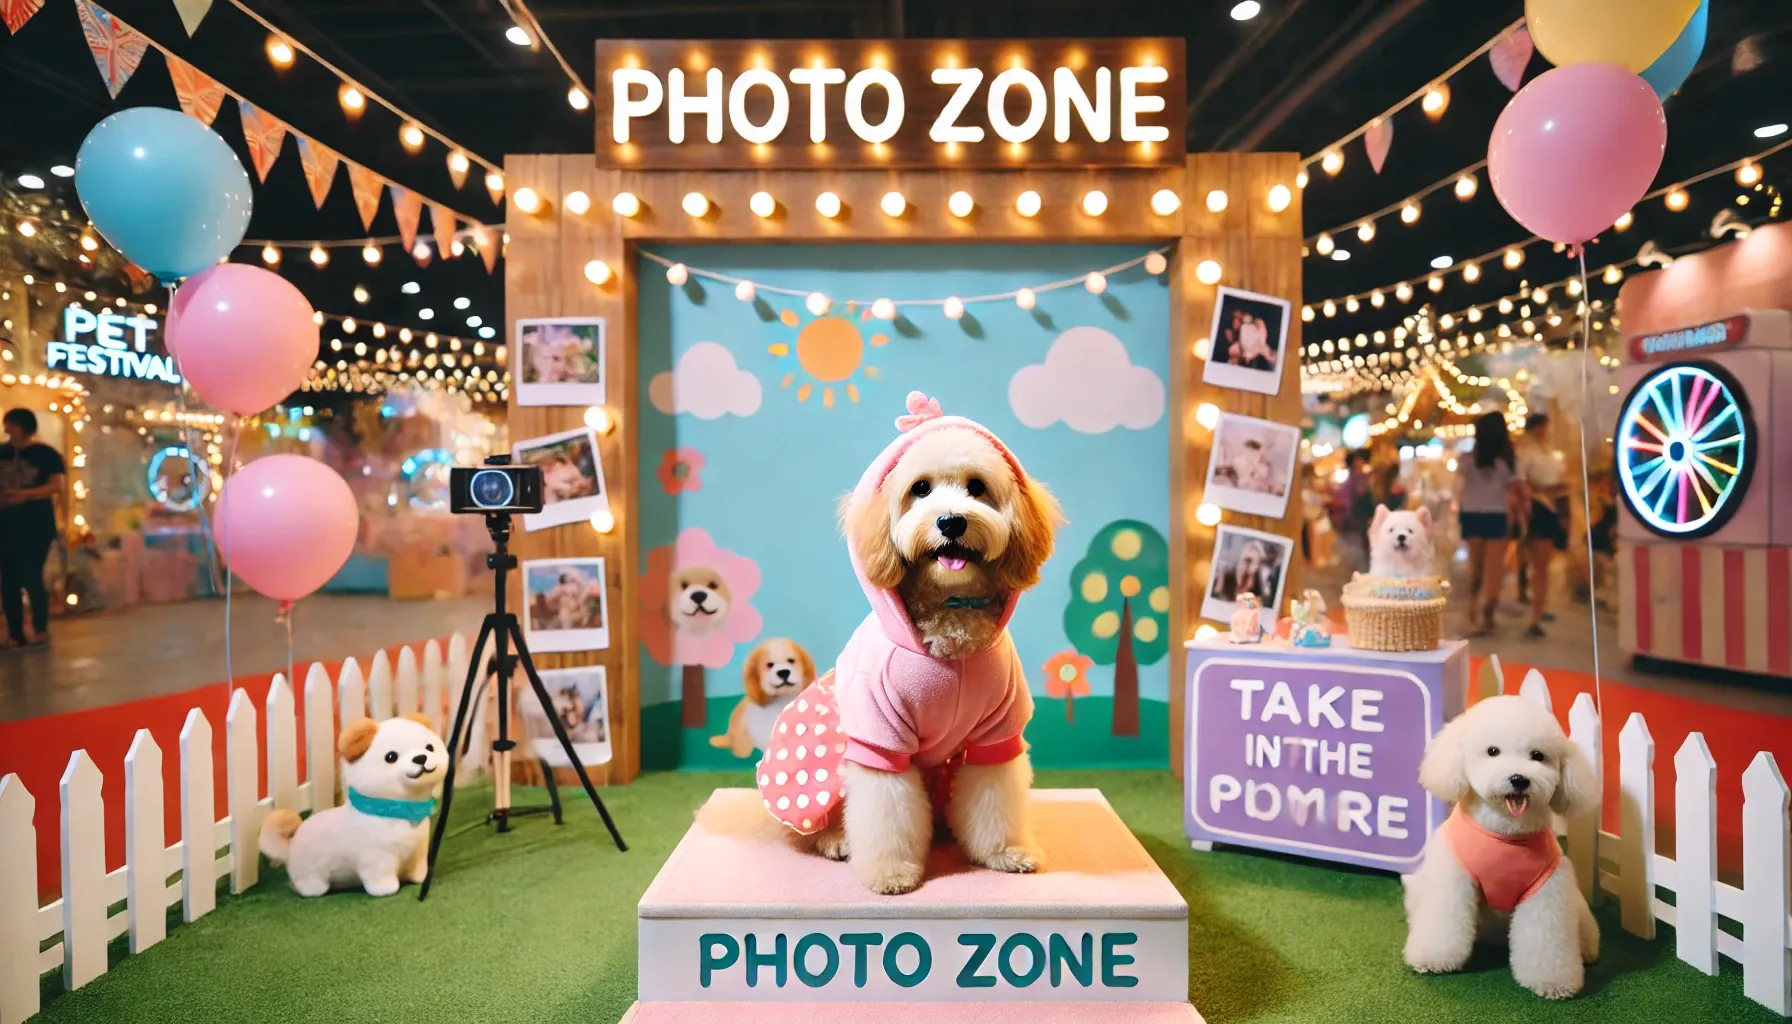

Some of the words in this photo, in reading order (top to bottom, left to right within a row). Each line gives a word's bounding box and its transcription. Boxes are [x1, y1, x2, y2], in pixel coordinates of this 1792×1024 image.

[612, 67, 905, 144] PHOTO
[929, 66, 1169, 144] ZONE
[64, 307, 158, 352] PET
[47, 341, 182, 384] FESTIVAL
[1230, 679, 1384, 732] TAKE
[1245, 733, 1280, 768] IN
[1300, 738, 1373, 779] THE
[699, 932, 932, 988] PHOTO
[956, 932, 1139, 988] ZONE
